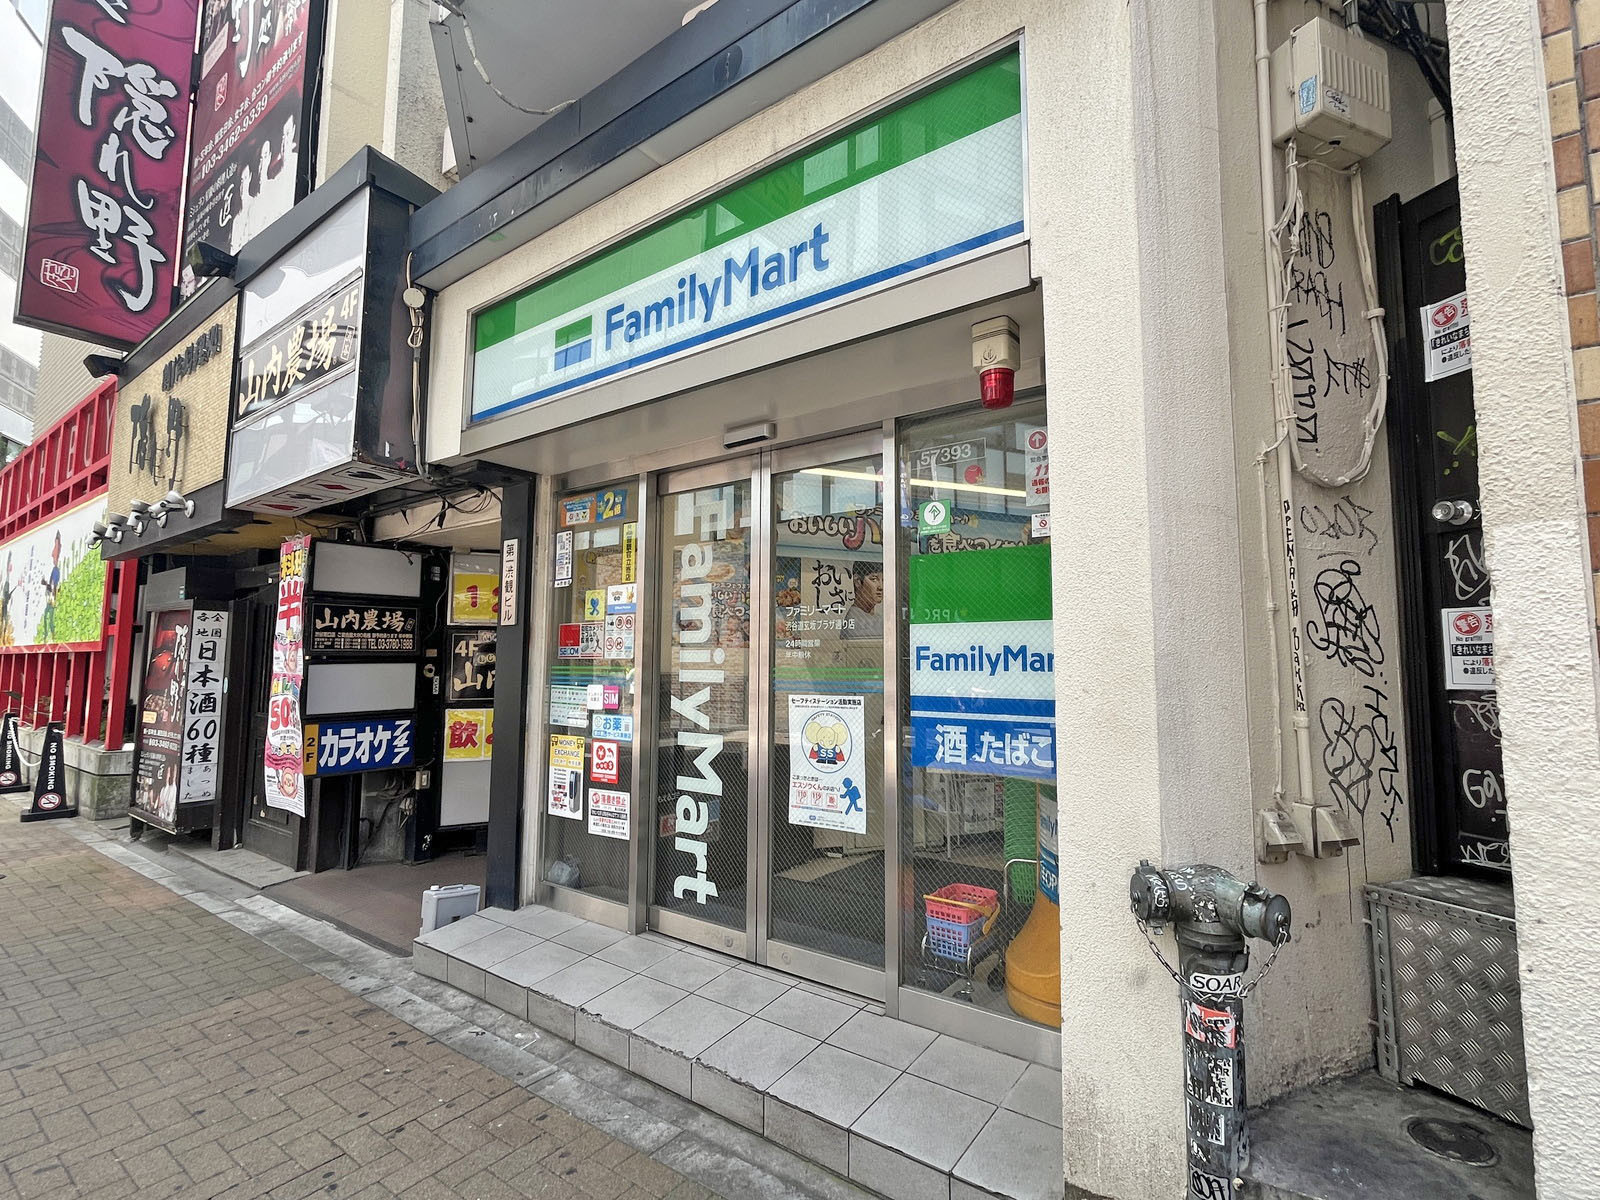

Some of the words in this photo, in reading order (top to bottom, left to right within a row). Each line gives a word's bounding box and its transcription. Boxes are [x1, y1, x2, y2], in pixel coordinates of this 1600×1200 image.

[605, 222, 830, 351] FamilyMart
[341, 288, 359, 320] 4F
[239, 305, 337, 416] 山内農場
[920, 443, 972, 466] 57393
[315, 607, 405, 632] 山内農場
[785, 604, 846, 617] ファミリーマート
[455, 640, 478, 657] 4F
[185, 640, 220, 764] 日本酒60種
[604, 693, 618, 704] SIM
[671, 490, 726, 905] FamilyMart
[603, 717, 622, 731] お薬
[50, 742, 57, 753] NO
[319, 727, 391, 768] カラオケ
[554, 749, 580, 757] EXCHANGE
[935, 724, 967, 765] 酒
[973, 731, 1054, 768] たばこ
[47, 756, 57, 790] SMOKING
